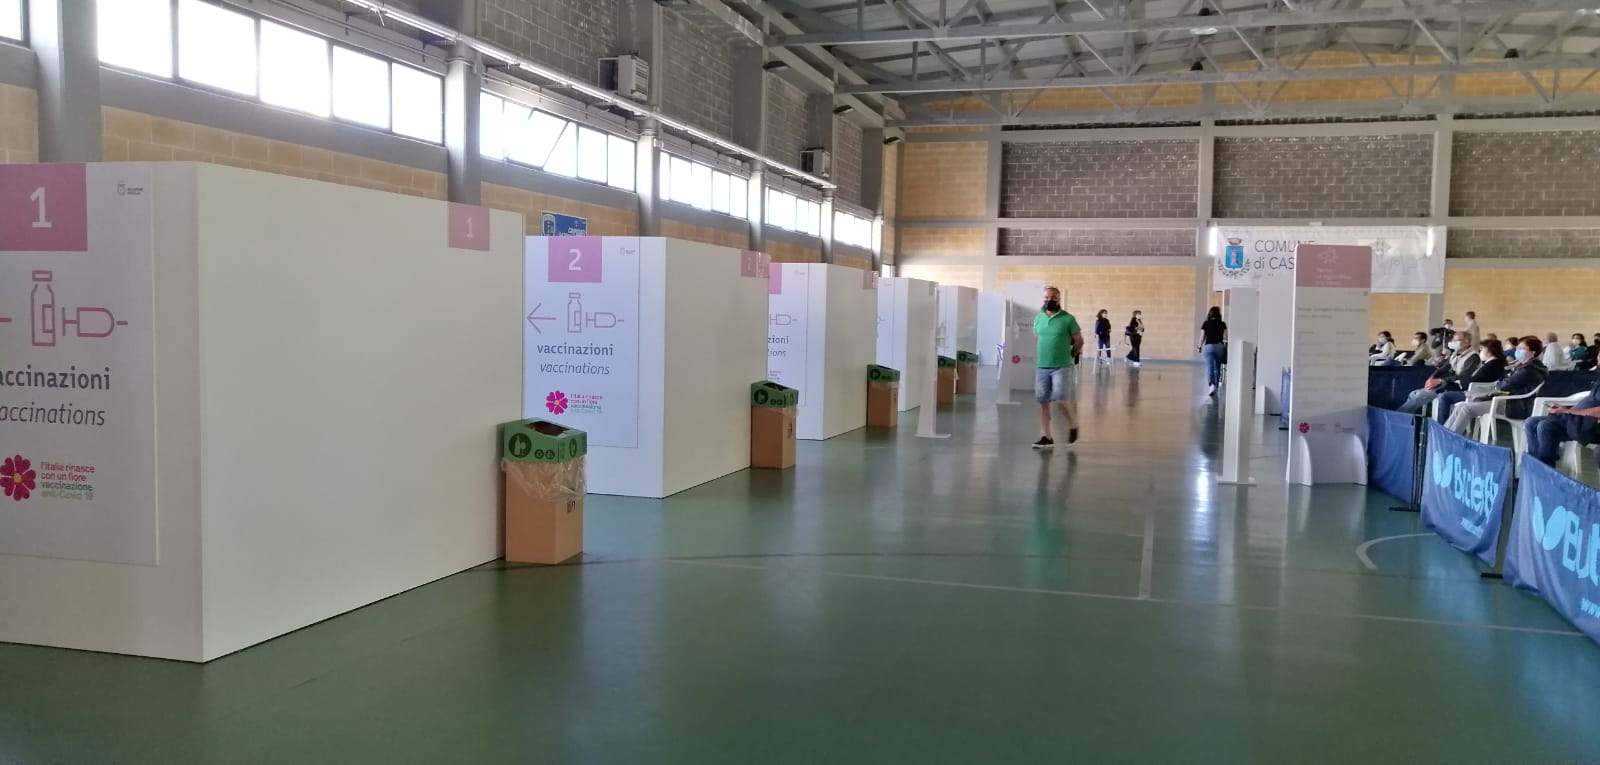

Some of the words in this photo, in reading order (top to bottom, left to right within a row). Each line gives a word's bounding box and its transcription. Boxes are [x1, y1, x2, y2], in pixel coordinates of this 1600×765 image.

[30, 186, 52, 228] 1
[466, 217, 474, 238] 1
[1255, 239, 1315, 253] COMU
[568, 249, 582, 271] 2
[1254, 256, 1265, 270] di
[537, 342, 614, 356] vaccinazioni
[540, 361, 611, 375] vaccinations
